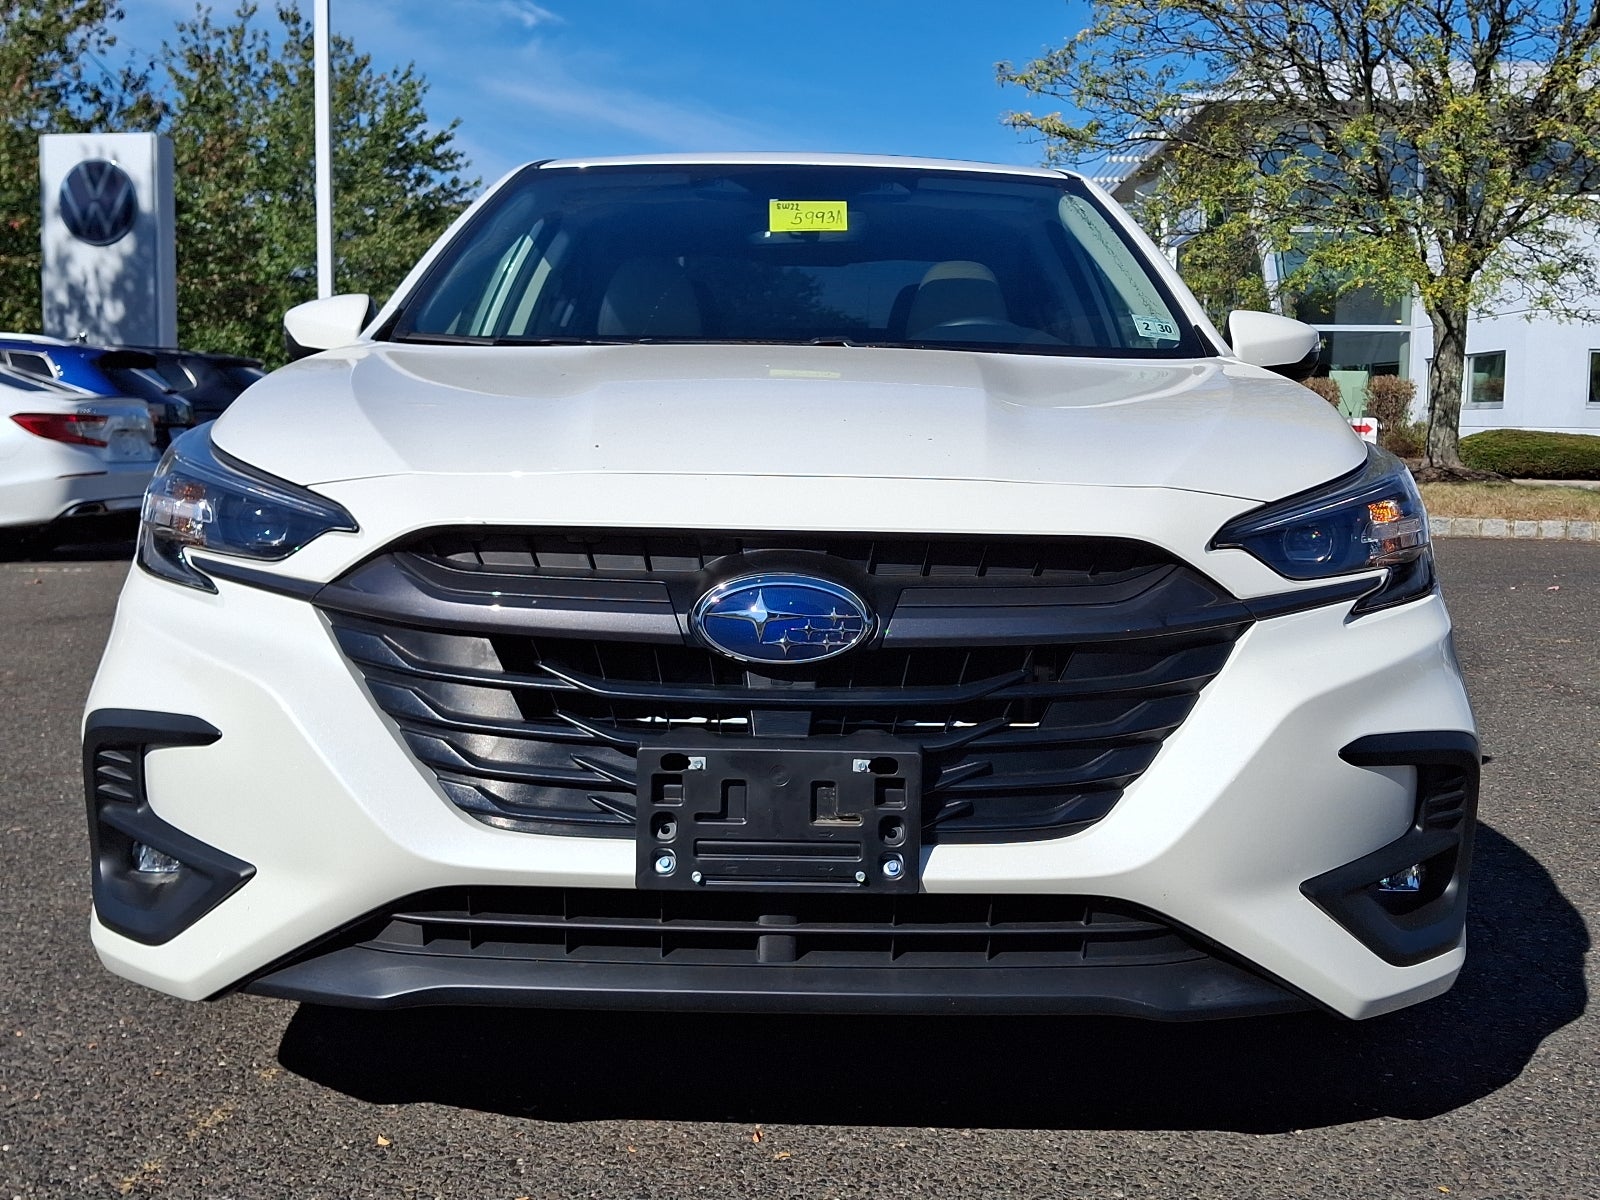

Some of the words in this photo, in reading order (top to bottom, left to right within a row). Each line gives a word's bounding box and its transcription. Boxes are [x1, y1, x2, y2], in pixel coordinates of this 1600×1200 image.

[62, 161, 133, 241] VW
[790, 209, 843, 225] 5993A
[1142, 321, 1152, 331] 2
[1157, 323, 1173, 334] 30
